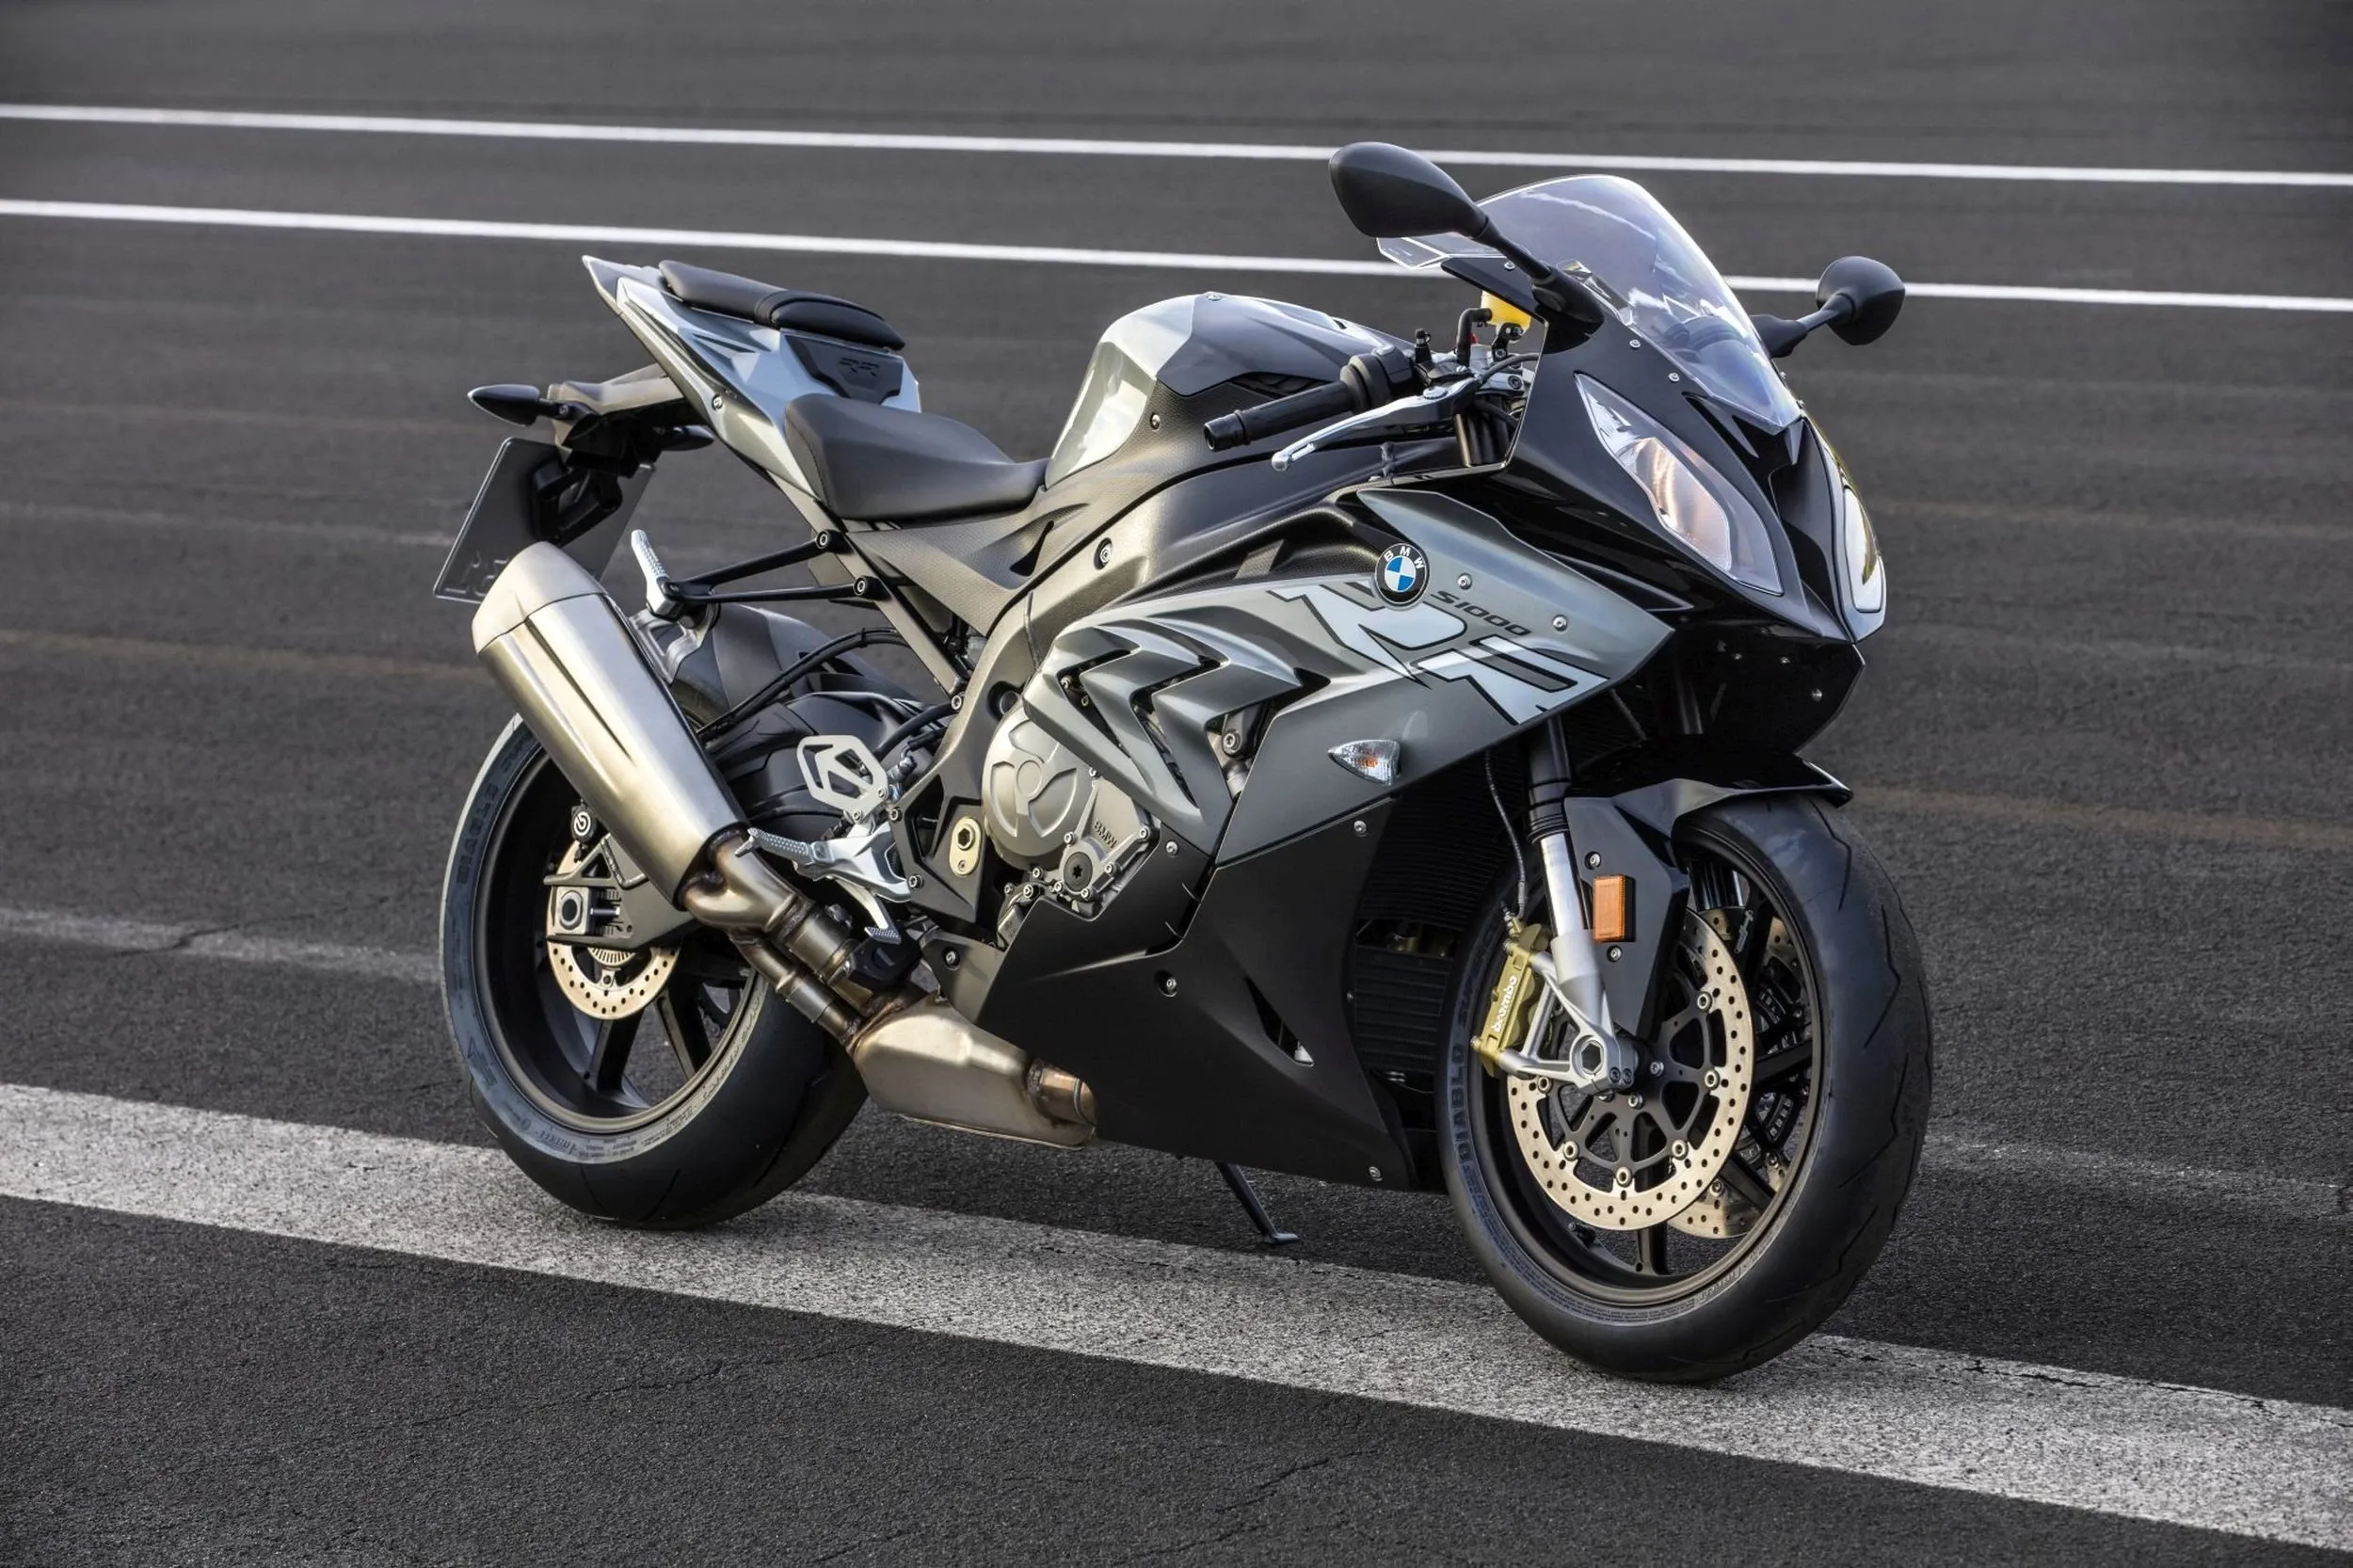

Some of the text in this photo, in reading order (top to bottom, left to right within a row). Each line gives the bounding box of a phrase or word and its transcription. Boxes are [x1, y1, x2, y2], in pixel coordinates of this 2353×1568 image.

[1383, 546, 1426, 570] BMW
[1094, 821, 1118, 849] BMW
[1490, 974, 1518, 1033] brembo
[1450, 1043, 1473, 1164] DIABLO
